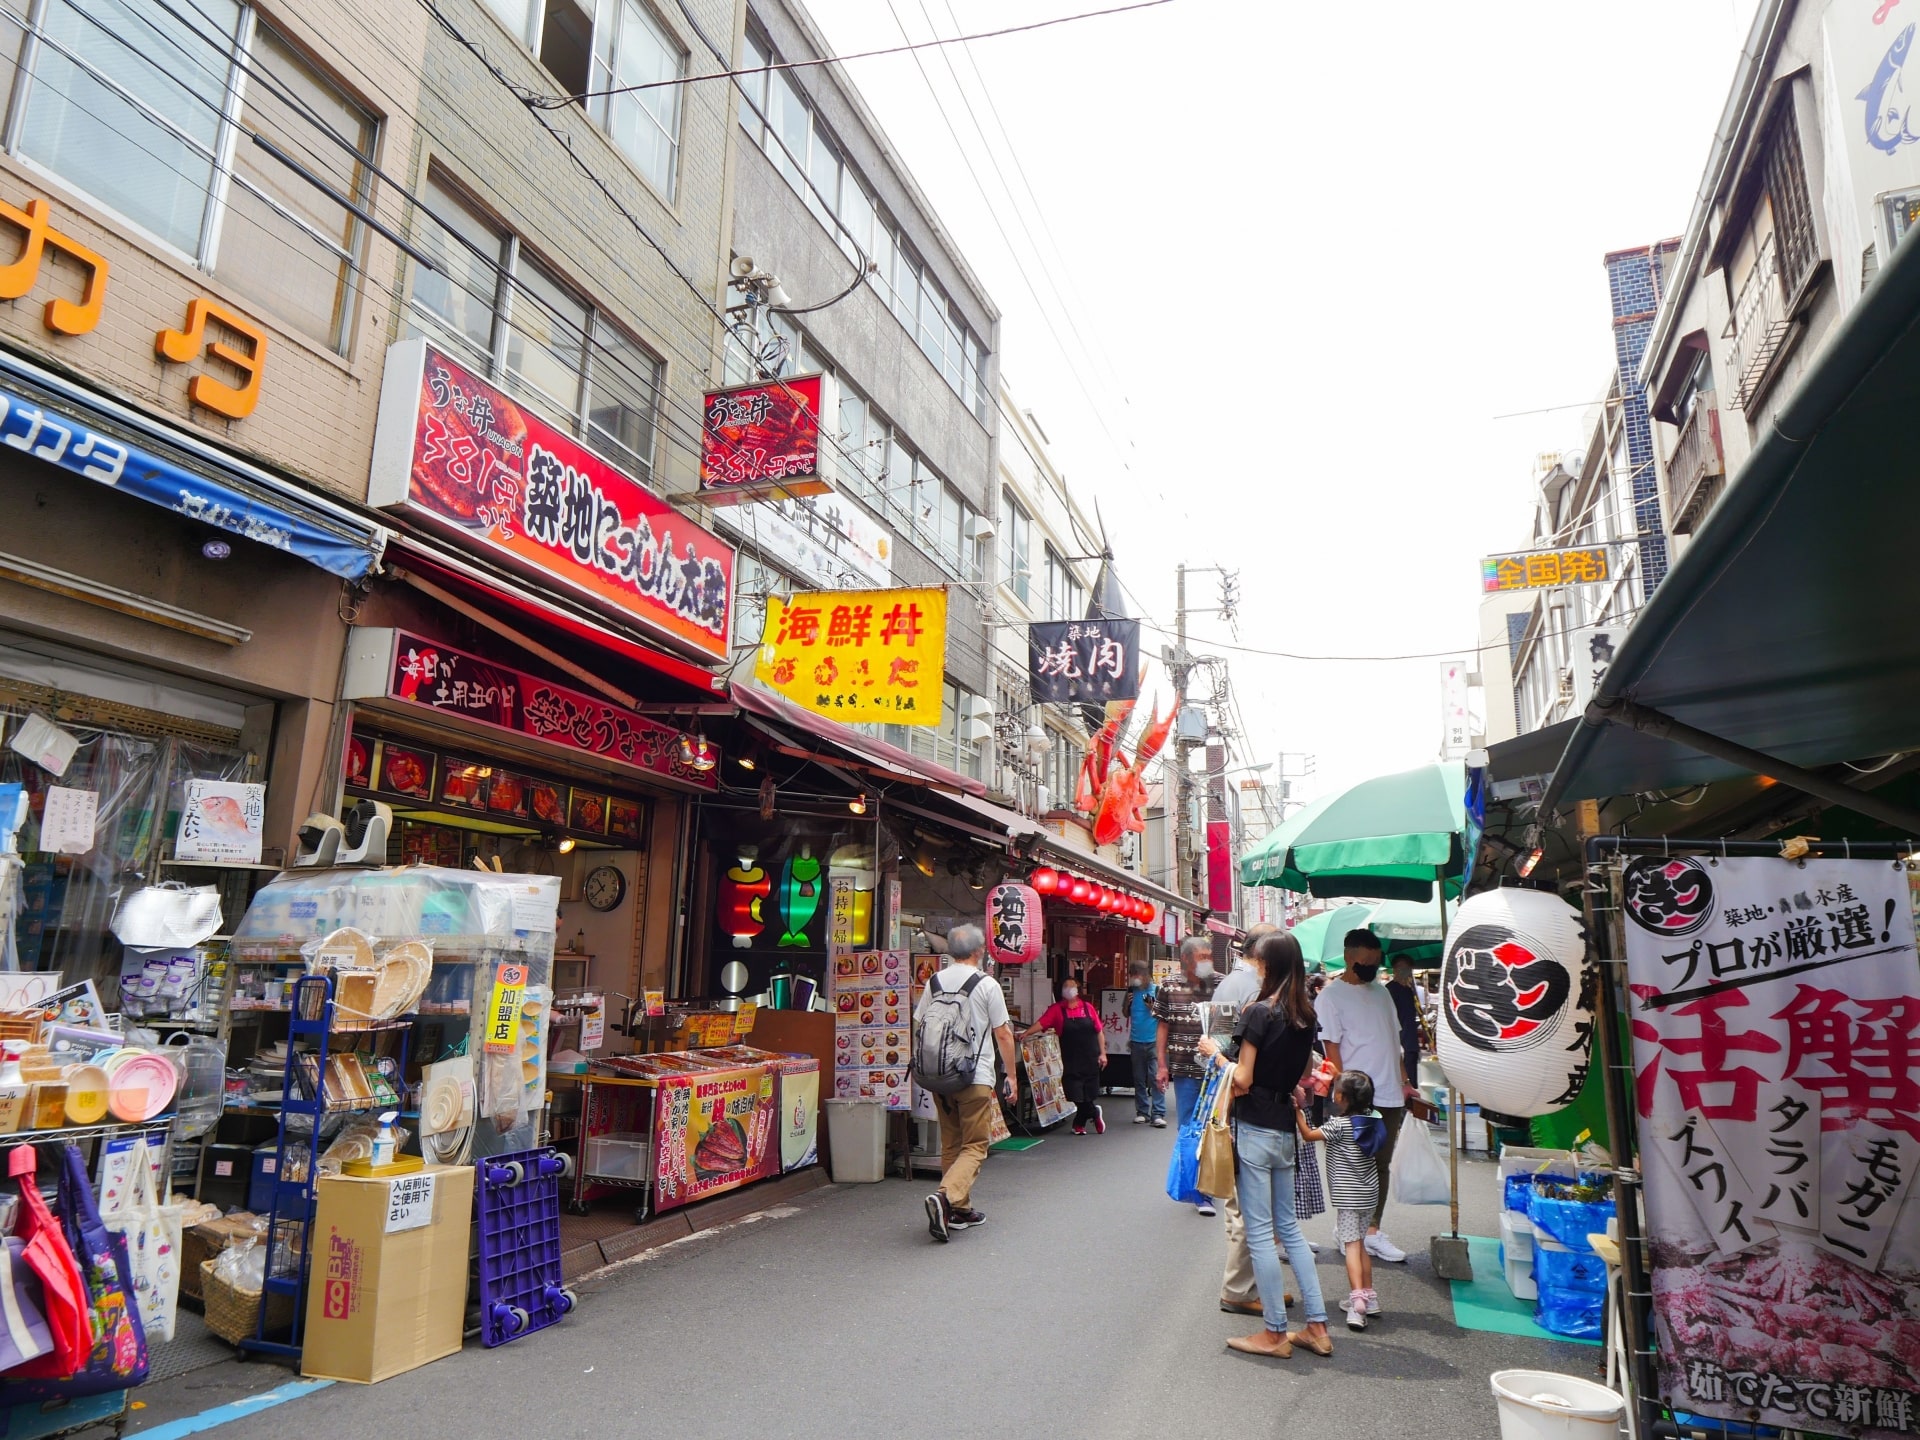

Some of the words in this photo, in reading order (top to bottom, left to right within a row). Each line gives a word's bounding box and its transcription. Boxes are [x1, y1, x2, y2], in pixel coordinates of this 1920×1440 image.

[431, 367, 495, 437] うな丼
[709, 392, 774, 432] うな丼
[422, 412, 519, 512] 381円
[486, 427, 523, 460] UNADON
[775, 602, 925, 648] 海鮮丼
[1067, 624, 1103, 642] 築地
[401, 648, 459, 680] 毎日が
[1037, 637, 1125, 680] 焼肉
[432, 680, 516, 708] 土用丑の日
[243, 785, 261, 830] 築地に
[1723, 882, 1859, 929] 築地・水産
[1661, 898, 1896, 991] プロが厳選!
[494, 987, 517, 1040] 加盟店
[1102, 1011, 1131, 1032] 焼
[1667, 1115, 1752, 1244] ズワイ
[1759, 1095, 1810, 1219] タラバ
[391, 1189, 431, 1207] ご使用下
[392, 1176, 432, 1193] 入店前に
[1822, 1137, 1902, 1259] 毛ガニ
[390, 1207, 410, 1221] さい
[1688, 1360, 1914, 1432] 茹でたて新鮮
